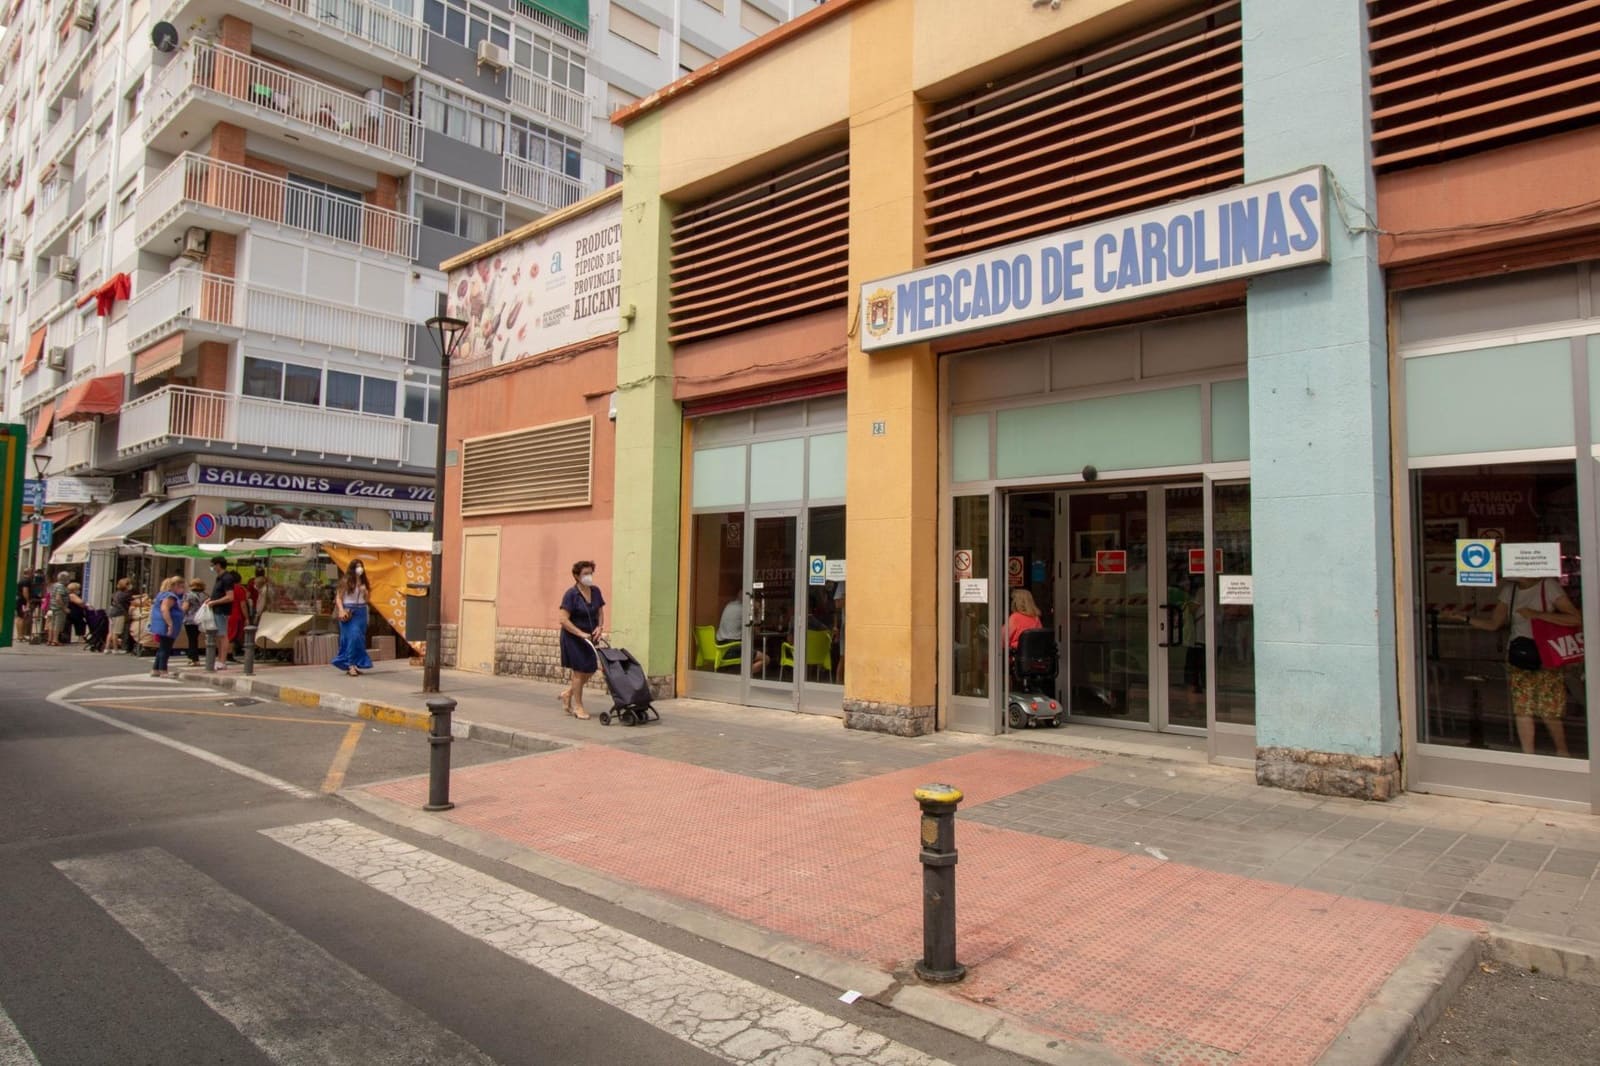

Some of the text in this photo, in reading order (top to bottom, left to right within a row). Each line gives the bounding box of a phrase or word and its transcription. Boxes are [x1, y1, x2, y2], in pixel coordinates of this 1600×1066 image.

[575, 223, 622, 259] PRODUCT
[896, 183, 1319, 335] MERCADO DE CAROLINAS
[574, 268, 615, 296] PROVINCIA
[205, 467, 330, 492] SALAZONES
[344, 479, 395, 498] Cala
